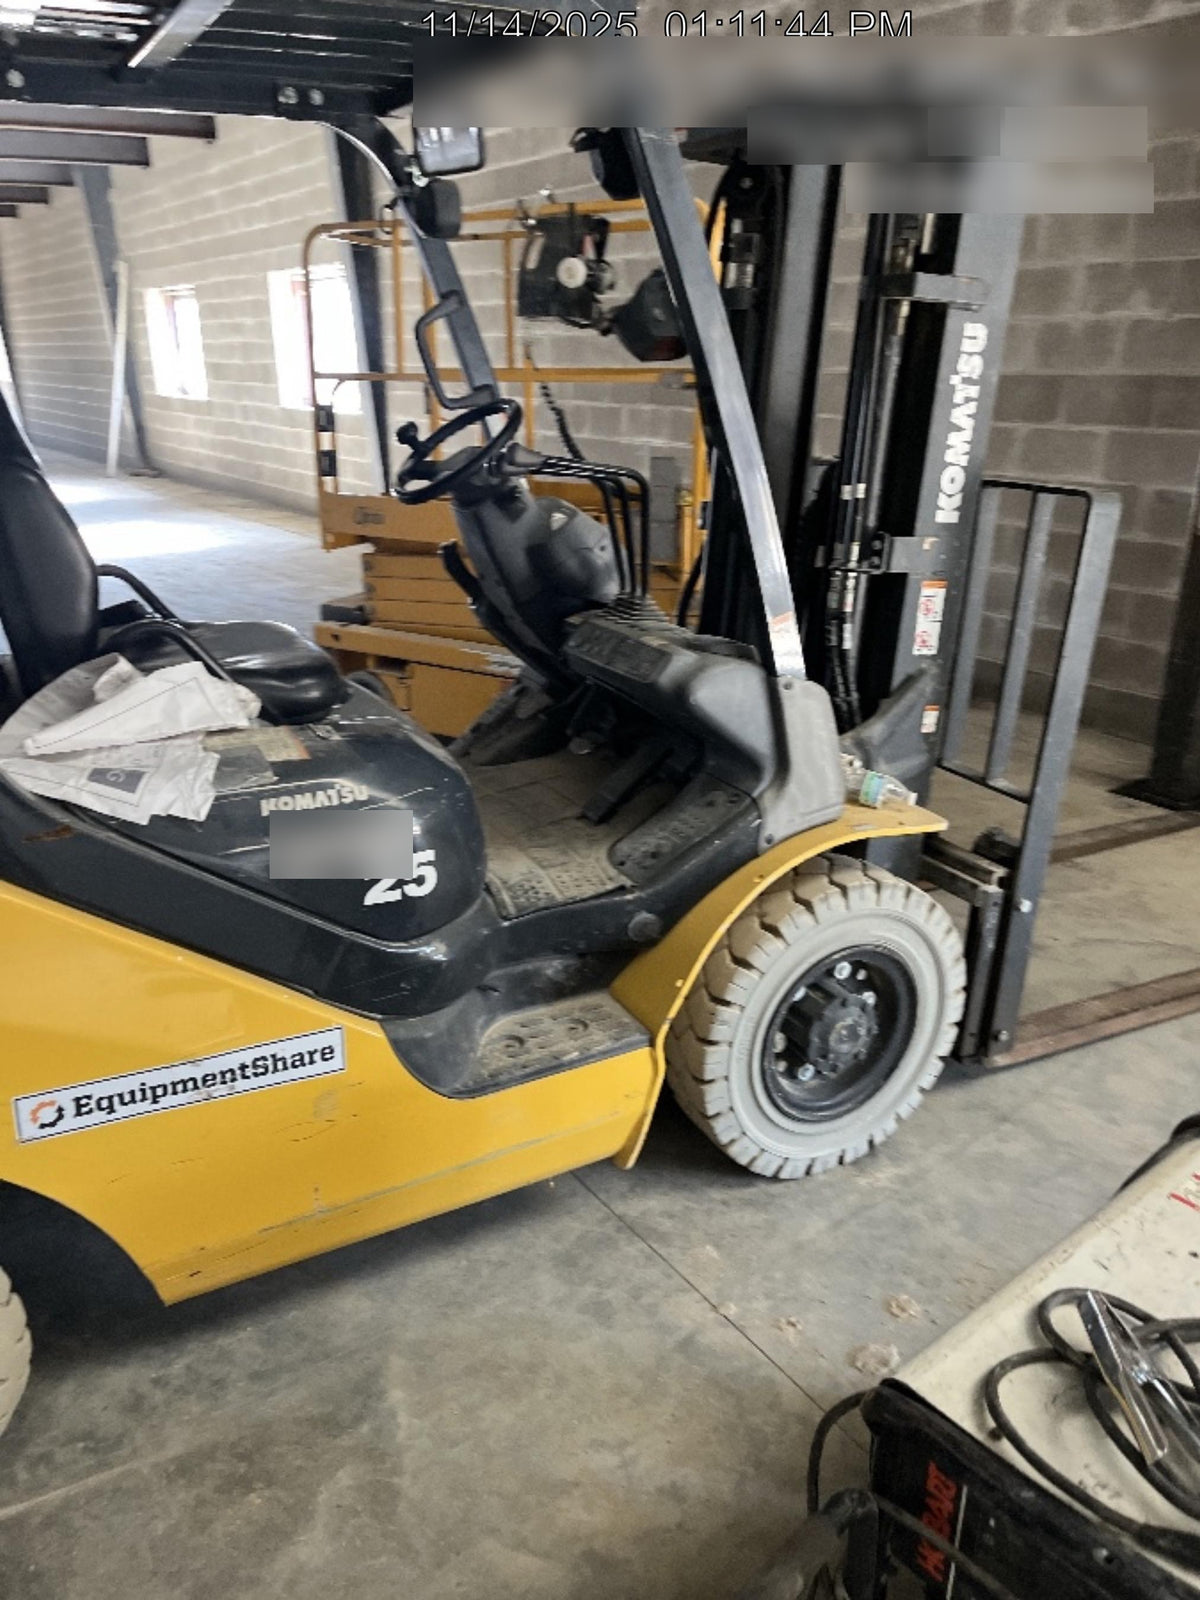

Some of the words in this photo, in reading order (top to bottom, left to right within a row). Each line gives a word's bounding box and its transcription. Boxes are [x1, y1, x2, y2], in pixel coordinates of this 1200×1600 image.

[935, 322, 989, 524] KOMATSU
[259, 784, 370, 817] KOMATSU
[73, 1043, 336, 1118] EquipmentShare
